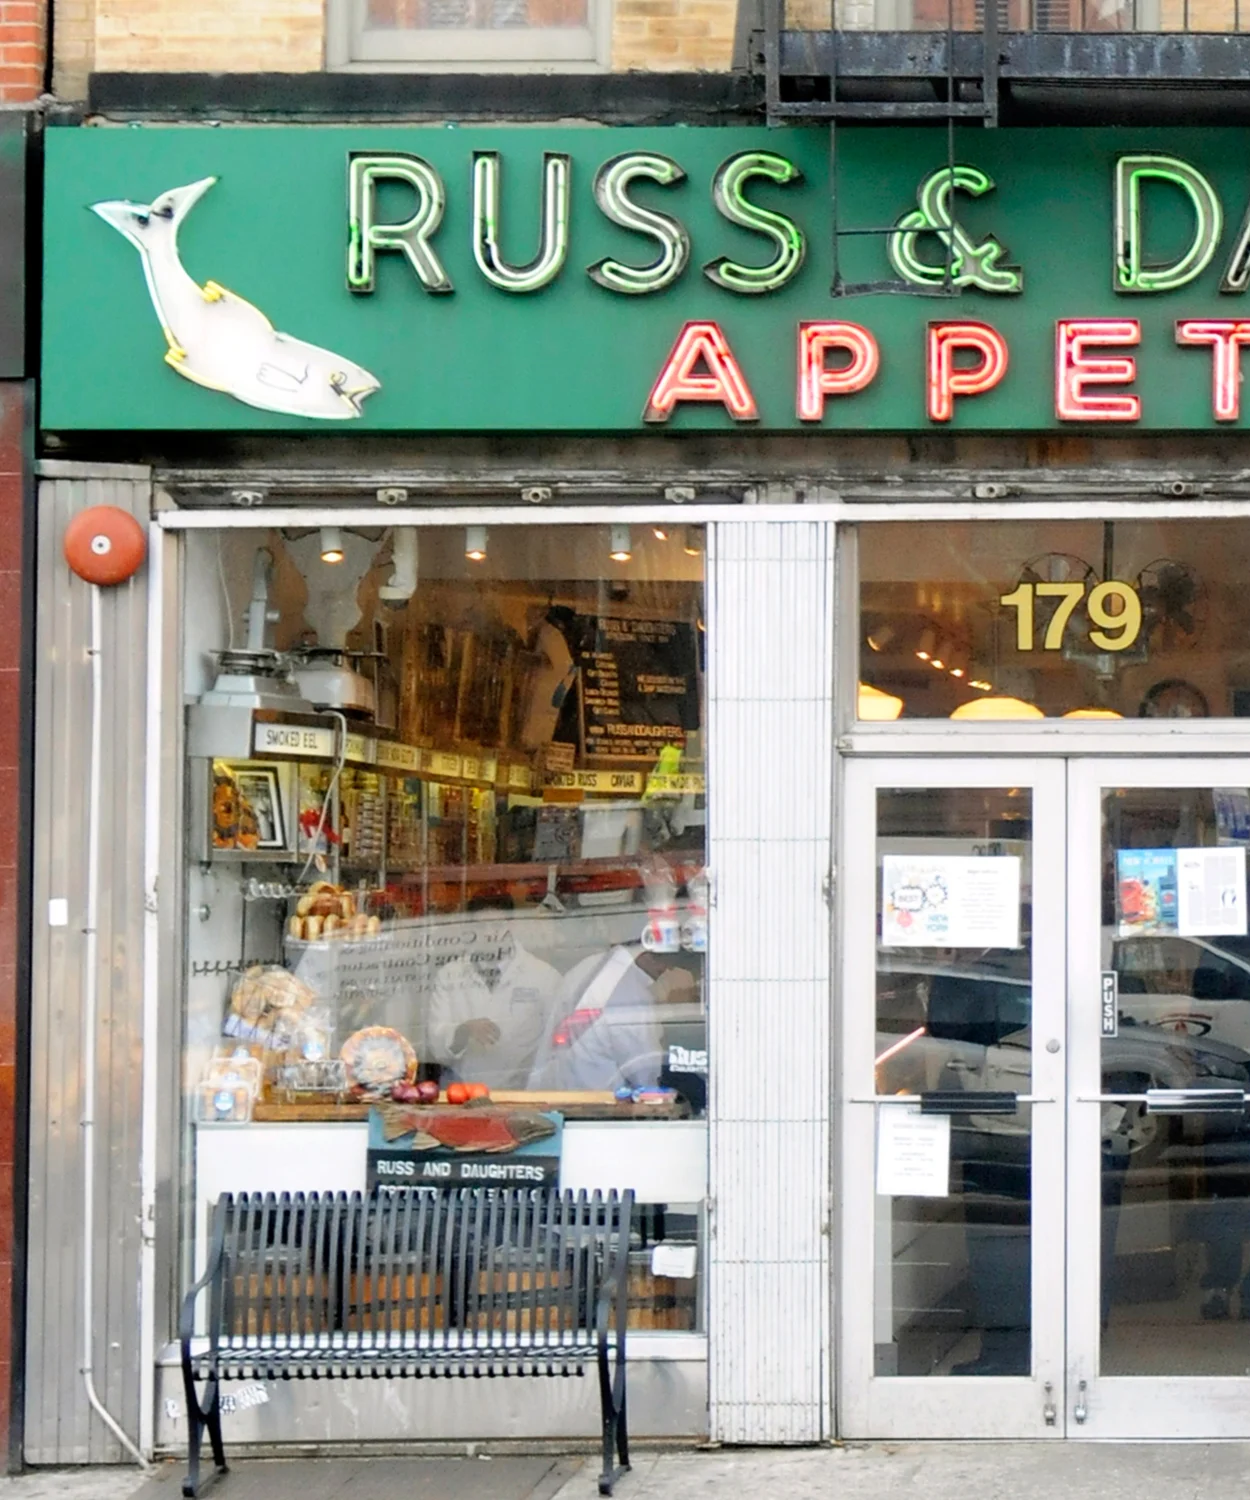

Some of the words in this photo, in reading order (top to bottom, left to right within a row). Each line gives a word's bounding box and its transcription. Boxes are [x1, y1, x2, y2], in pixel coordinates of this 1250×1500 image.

[346, 150, 807, 294] RUSS
[886, 164, 1023, 294] &
[1000, 580, 1142, 652] 179
[266, 729, 300, 748] SMOKED
[303, 732, 318, 749] EEL
[1103, 976, 1114, 1032] PUSH
[376, 1159, 415, 1176] RUSS
[422, 1161, 451, 1178] AND
[460, 1162, 545, 1182] DAUGHTERS
